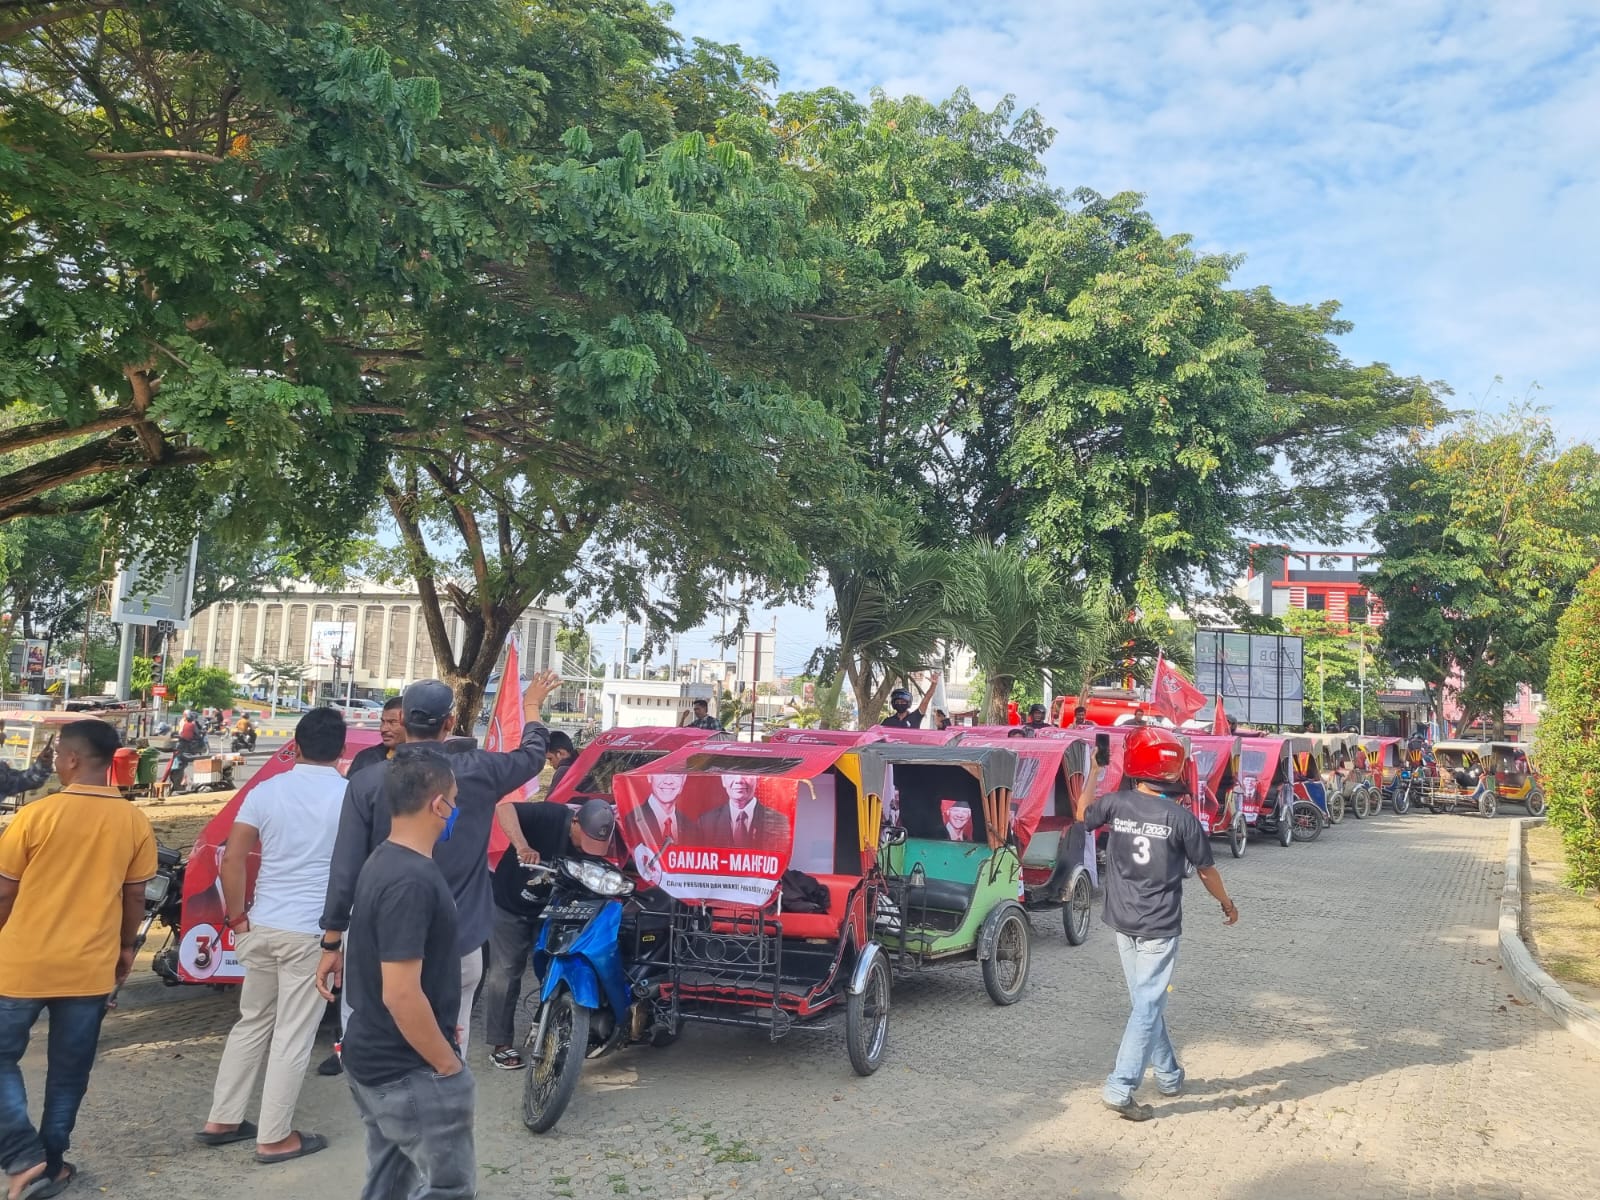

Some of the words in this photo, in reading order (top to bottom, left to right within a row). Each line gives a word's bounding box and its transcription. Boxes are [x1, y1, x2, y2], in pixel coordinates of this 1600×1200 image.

[1114, 824, 1142, 835] Mahfud
[668, 851, 719, 871] GANJAR
[729, 853, 779, 875] MAHFUD
[1132, 836, 1151, 866] 3
[194, 934, 211, 969] 3
